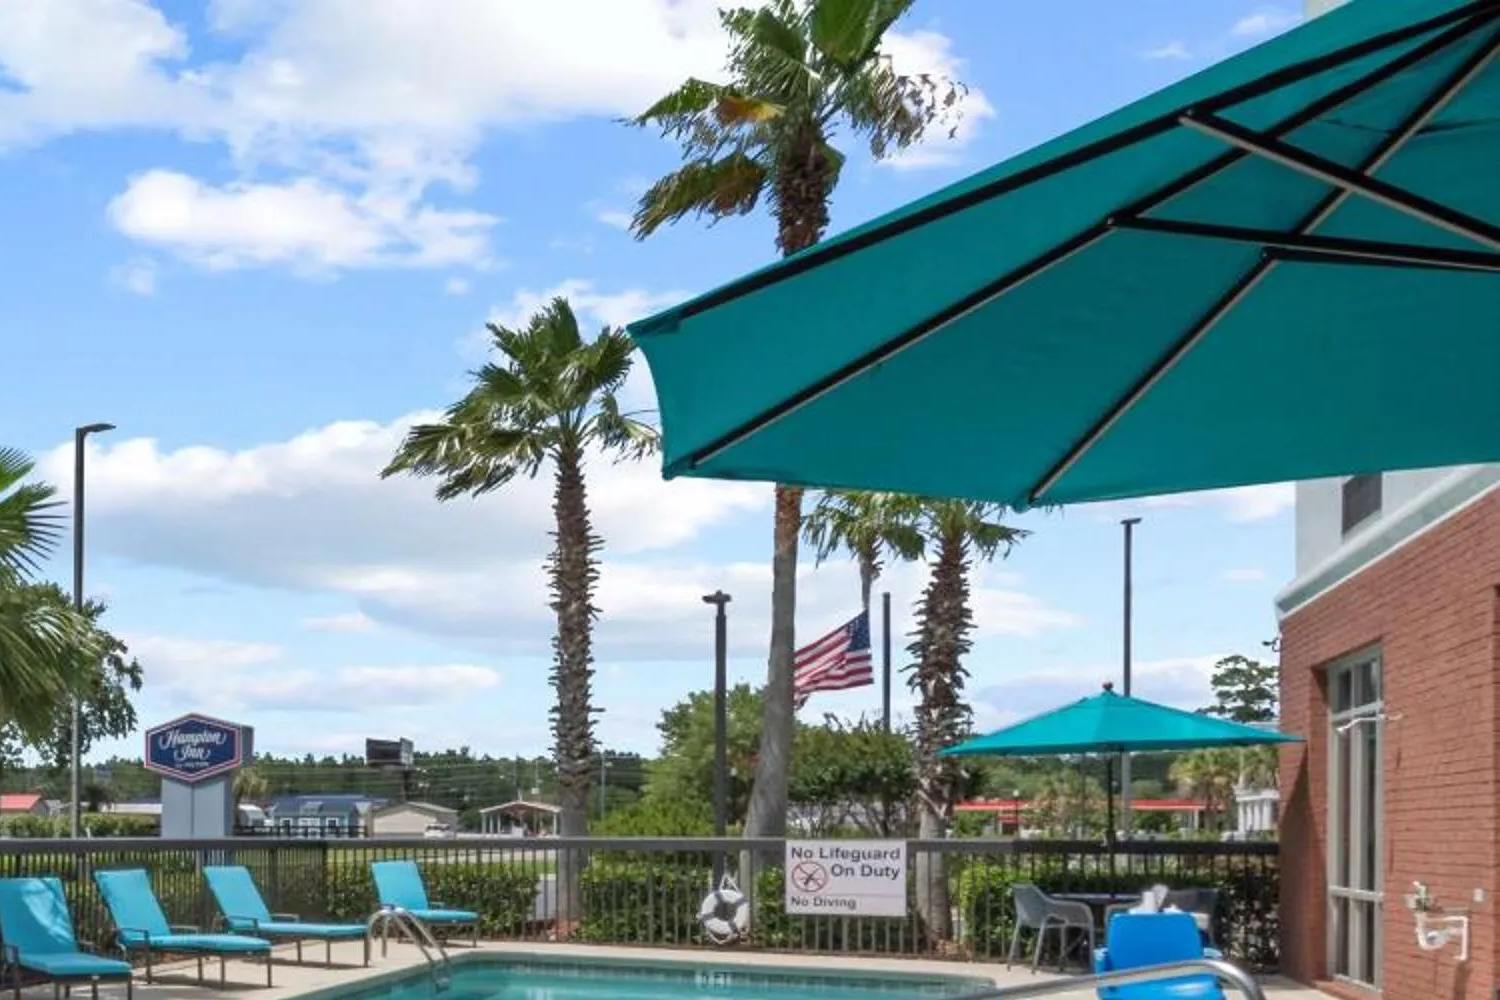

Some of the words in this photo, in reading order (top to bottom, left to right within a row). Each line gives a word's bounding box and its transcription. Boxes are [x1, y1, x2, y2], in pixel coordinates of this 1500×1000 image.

[158, 729, 227, 750] Hampton
[173, 747, 211, 762] Inn
[791, 847, 814, 859] No
[820, 847, 900, 862] Lifeguard
[831, 864, 855, 877] On
[861, 864, 900, 880] Duty
[791, 896, 809, 907] No
[813, 896, 857, 910] Diving
